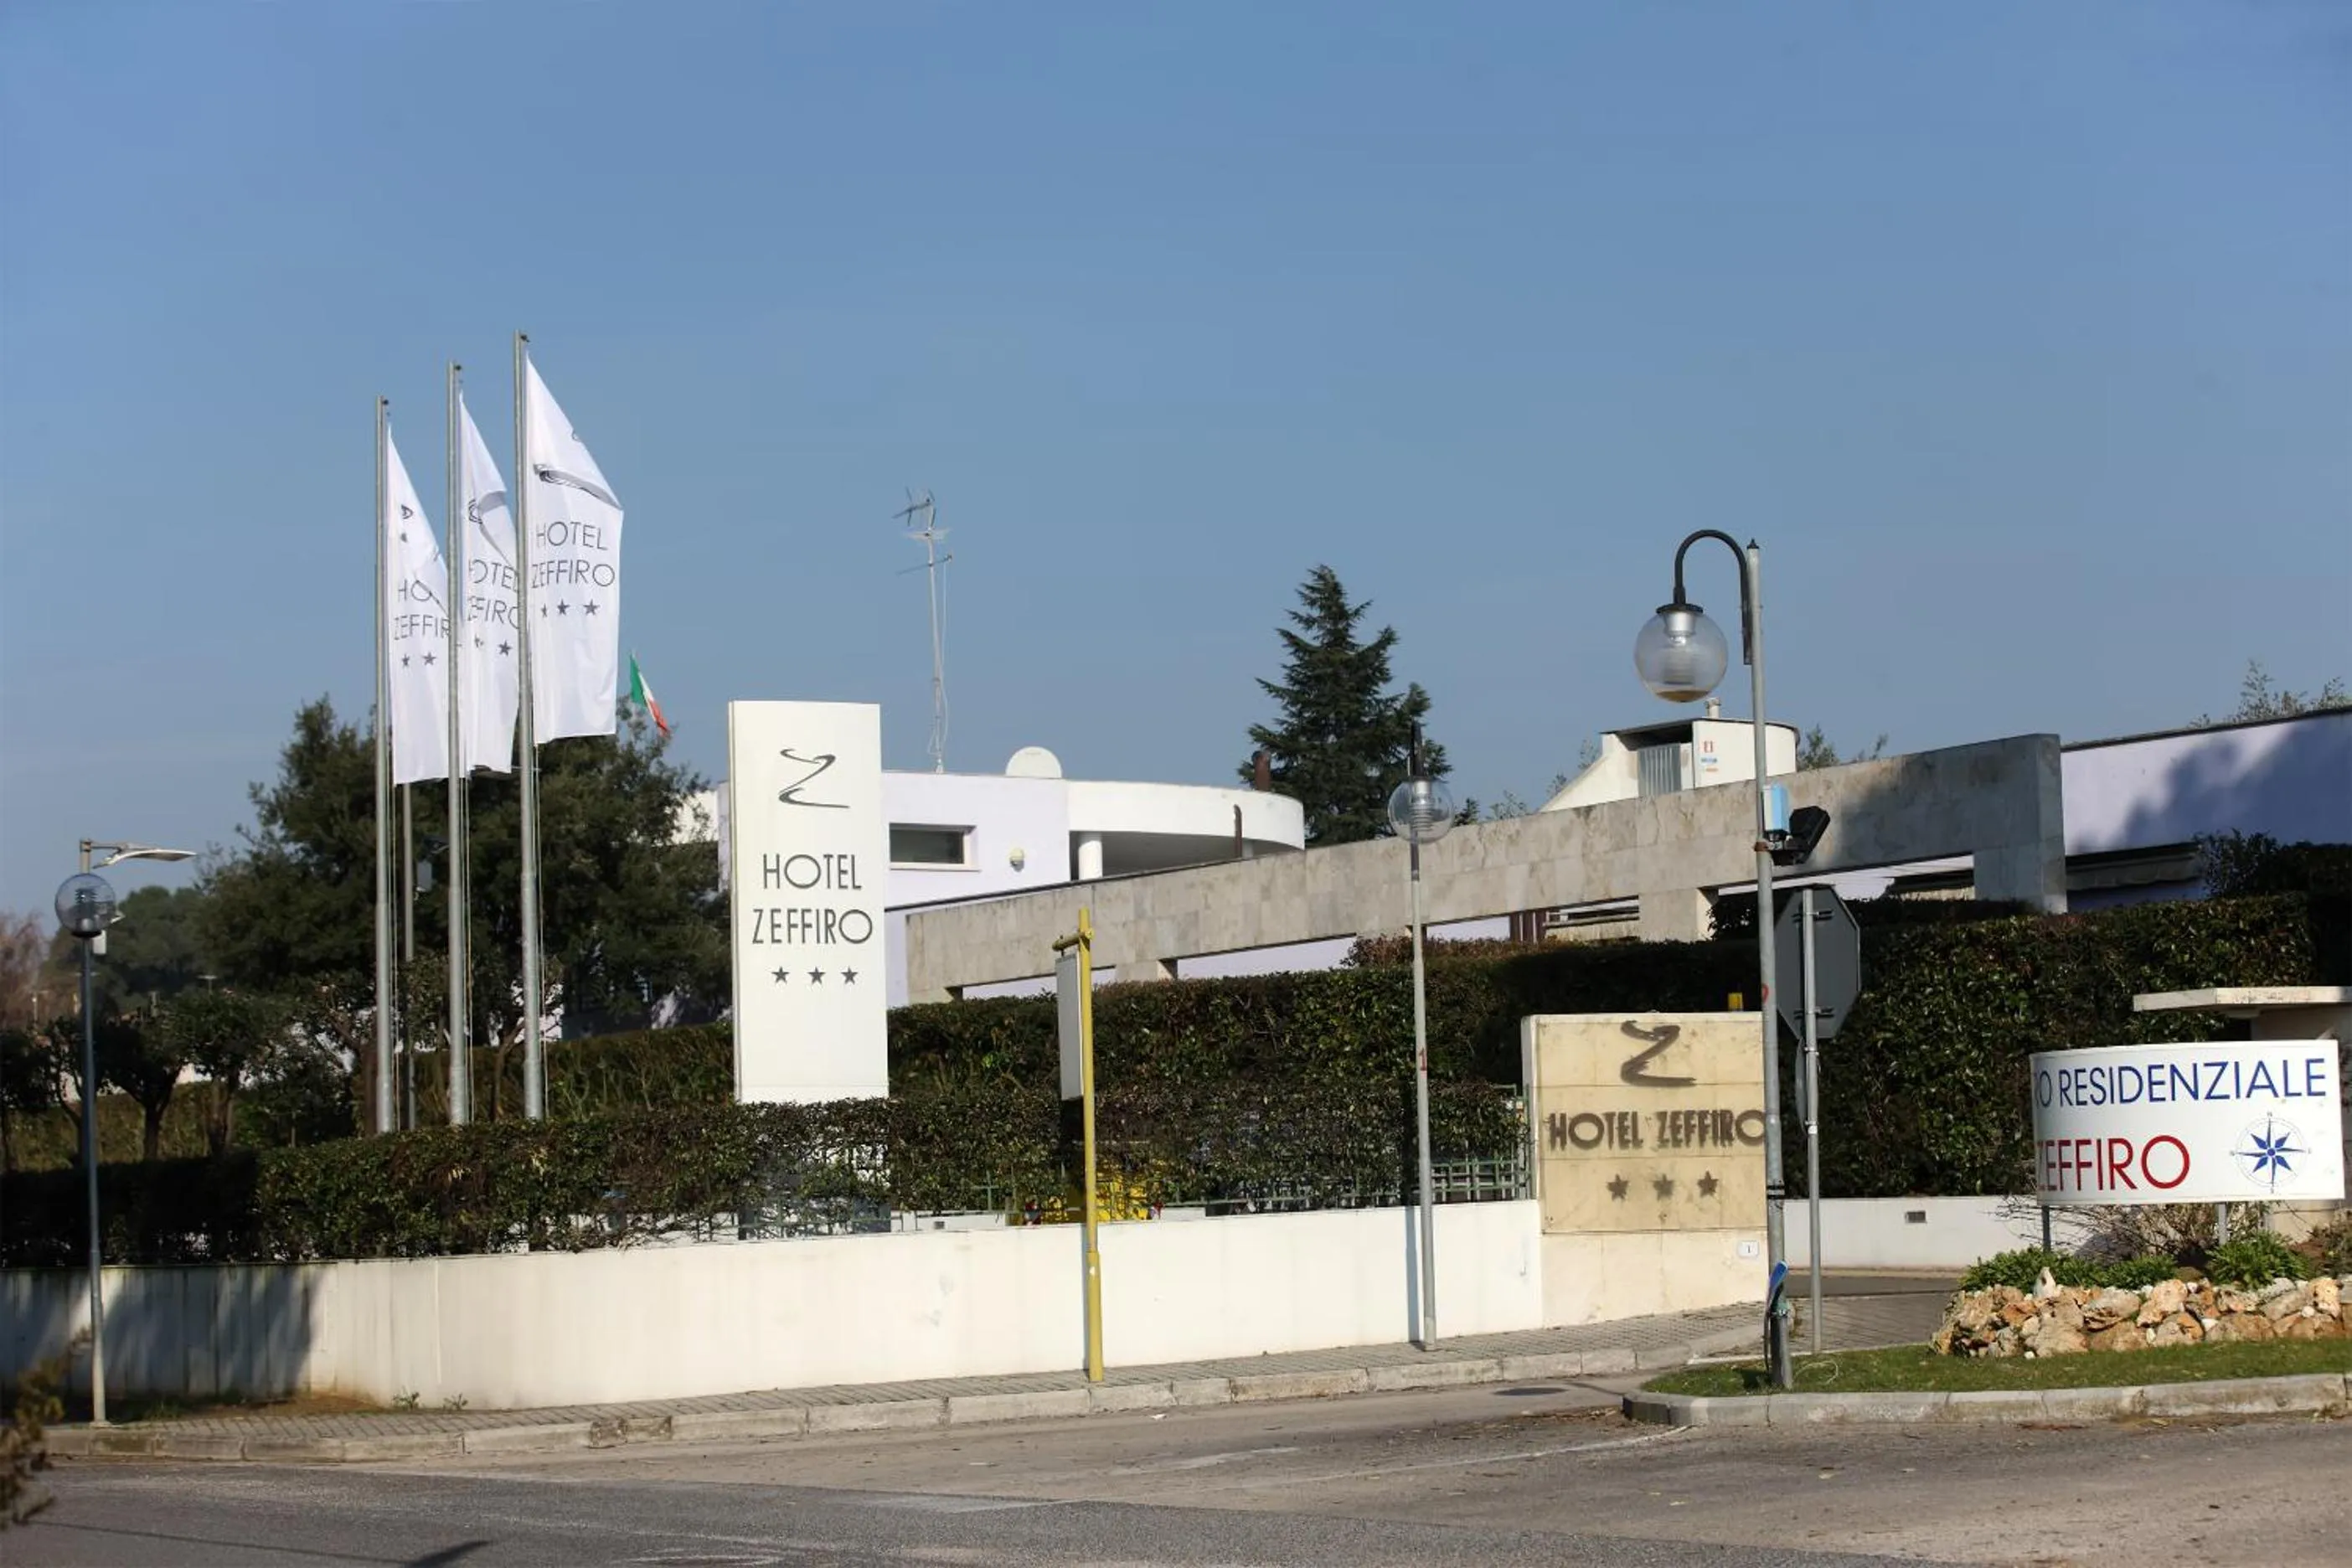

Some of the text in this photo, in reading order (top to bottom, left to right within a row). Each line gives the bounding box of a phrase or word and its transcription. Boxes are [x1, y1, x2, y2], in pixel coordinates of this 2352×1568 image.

[536, 521, 608, 550] HOTEL
[531, 559, 616, 588] ZEFFIRO
[763, 853, 862, 890] HOTEL
[752, 908, 873, 945] ZEFFIRO
[2058, 1058, 2327, 1107] RESIDENZIALE
[1548, 1108, 1766, 1152] HOTEL ZEFFIRO
